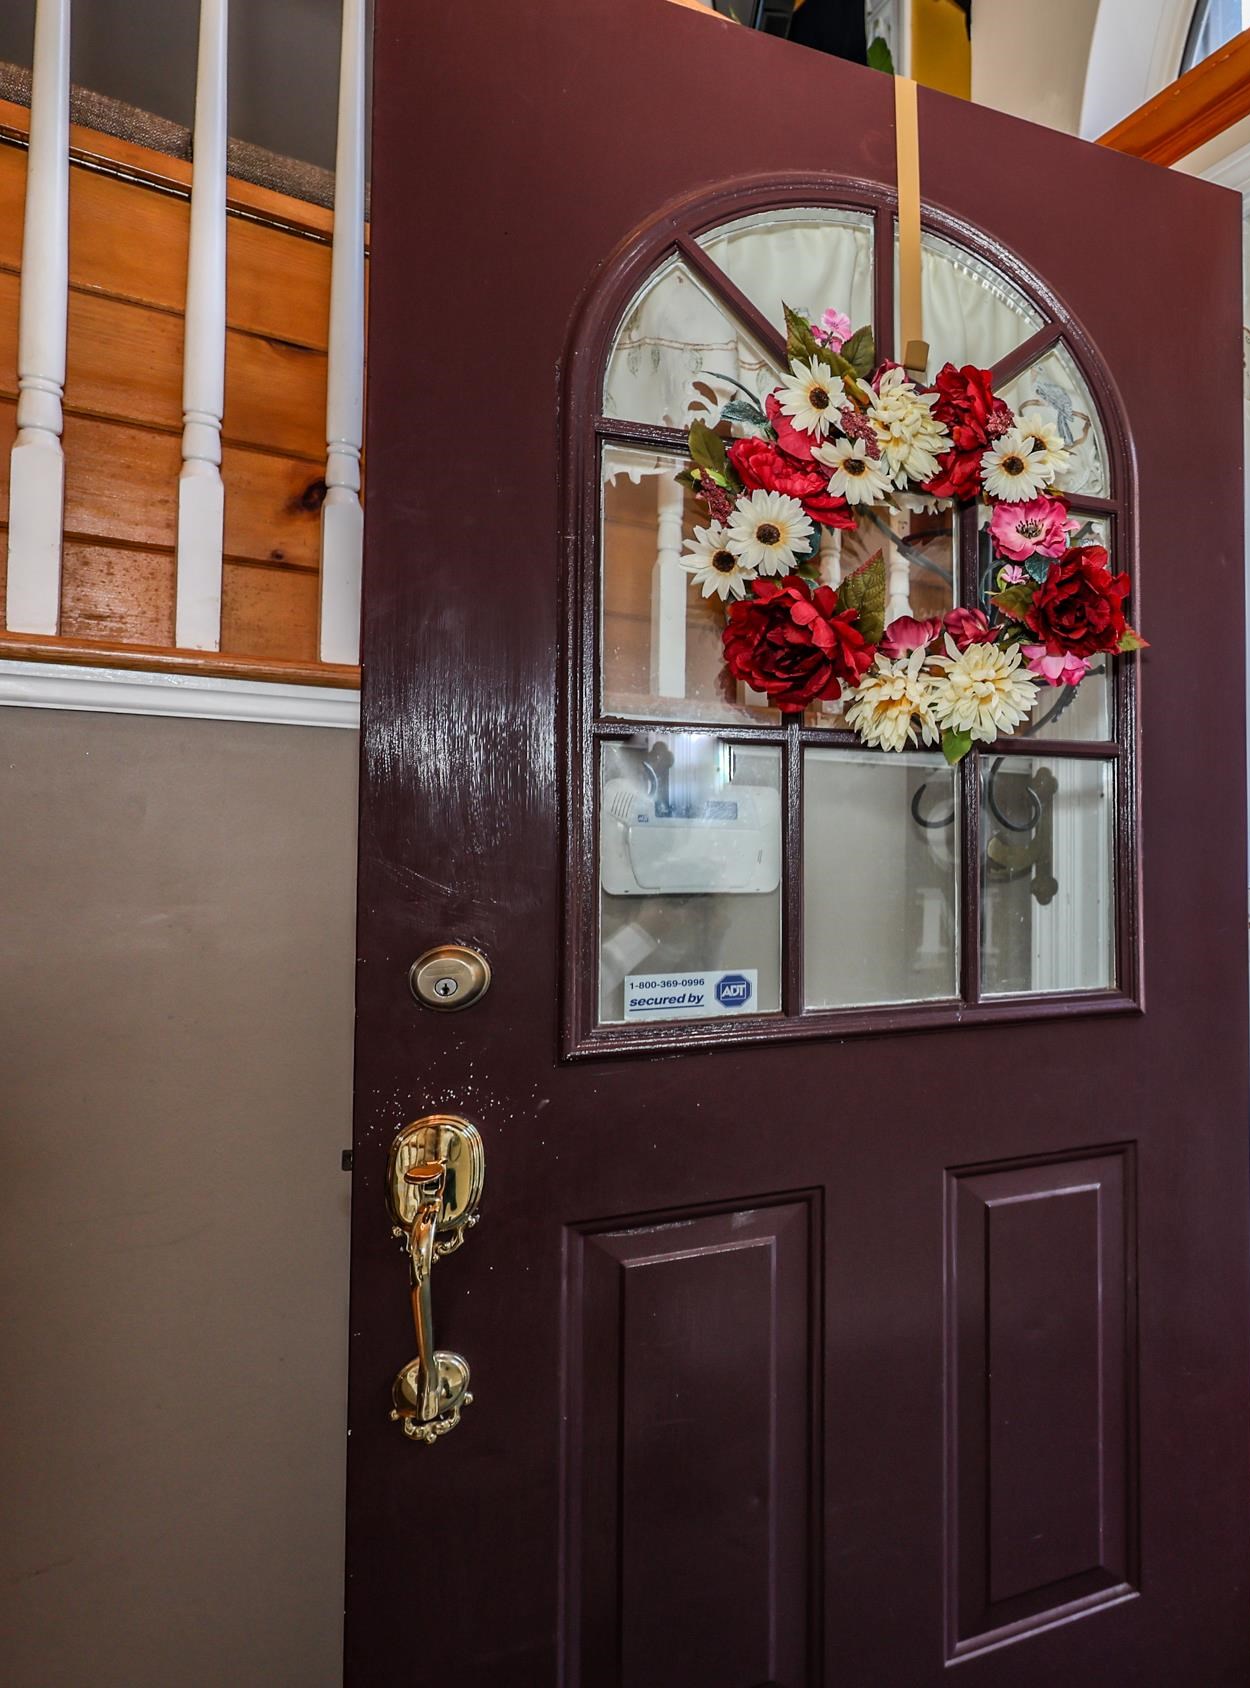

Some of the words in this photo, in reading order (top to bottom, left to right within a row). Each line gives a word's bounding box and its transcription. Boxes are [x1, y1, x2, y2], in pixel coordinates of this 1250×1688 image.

[629, 978, 704, 990] 1-800-369-0996
[721, 984, 746, 997] ADT
[629, 993, 686, 1006] secured
[687, 992, 704, 1004] by
